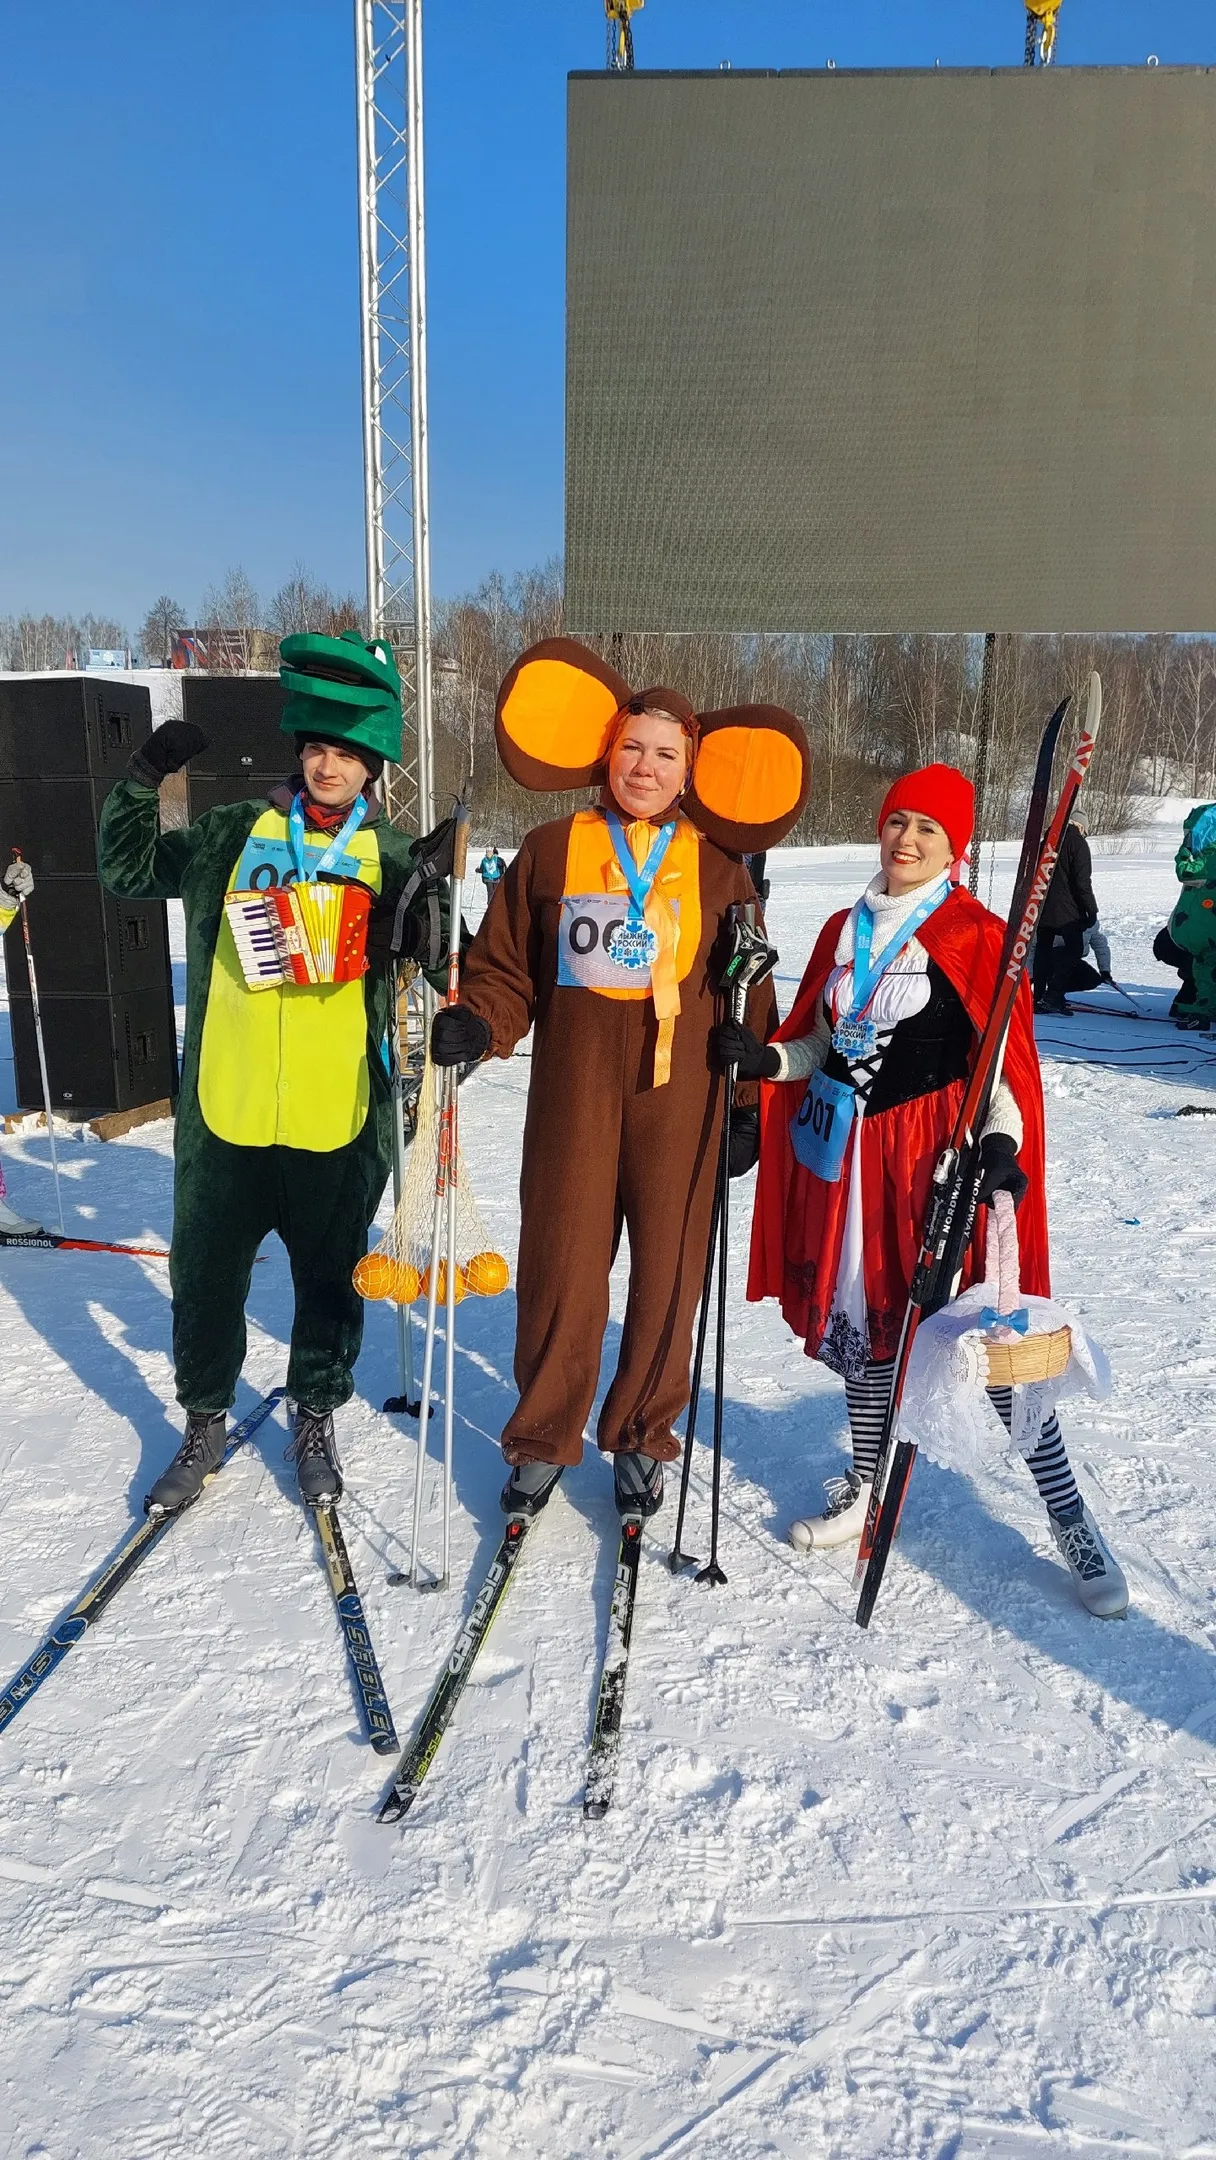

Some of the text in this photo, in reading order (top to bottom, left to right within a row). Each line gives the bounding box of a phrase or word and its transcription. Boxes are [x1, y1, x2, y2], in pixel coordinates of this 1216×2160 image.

[617, 932, 648, 940] ЛЫЖНЯ
[1006, 848, 1060, 982] NORDWAY
[617, 940, 648, 948] РОССИИ
[839, 1021, 868, 1032] ЛЫЖНЯ
[839, 1029, 867, 1040] РОССИИ
[797, 1089, 836, 1143] 001
[943, 1175, 965, 1234] NORDWAY
[963, 1177, 983, 1240] NORDWAY
[6, 1236, 55, 1248] ROSSIGNOL
[347, 1625, 390, 1730] SABLE
[414, 1731, 443, 1782] FISCHER
